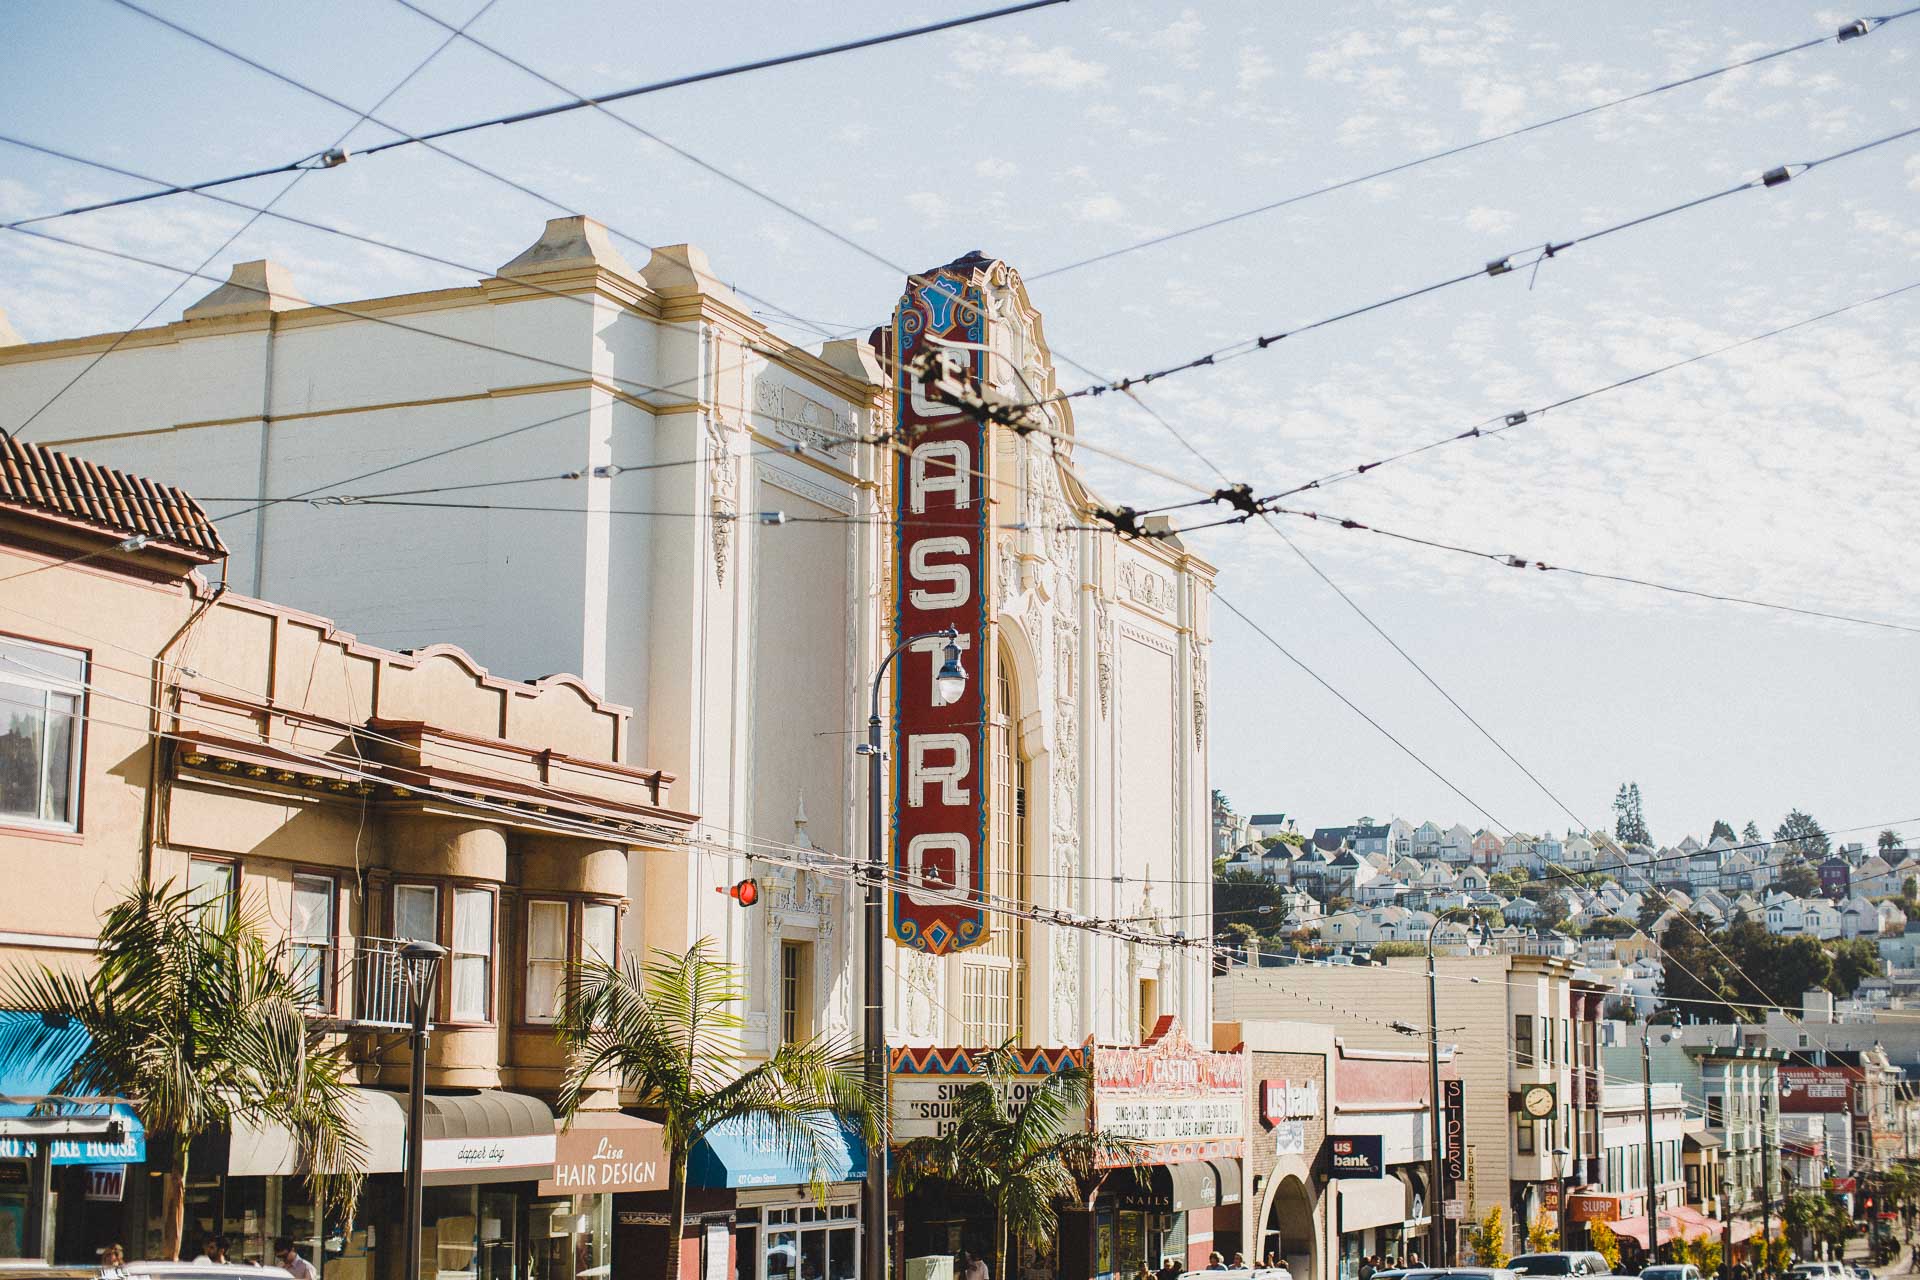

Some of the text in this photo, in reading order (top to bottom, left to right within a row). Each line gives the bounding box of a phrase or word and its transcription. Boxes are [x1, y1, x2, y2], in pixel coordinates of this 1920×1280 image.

[908, 346, 971, 906] CASTRO
[1154, 1060, 1197, 1083] CASTRO
[1448, 1081, 1462, 1179] SLIDERS
[86, 1137, 137, 1158] HOUSE
[458, 1143, 505, 1165] dapper dog
[592, 1136, 624, 1160] Lisa
[1333, 1154, 1369, 1167] bank
[556, 1161, 657, 1187] HAIR DESIGN
[1126, 1194, 1170, 1206] NAILS
[1582, 1201, 1612, 1213] SLURP
